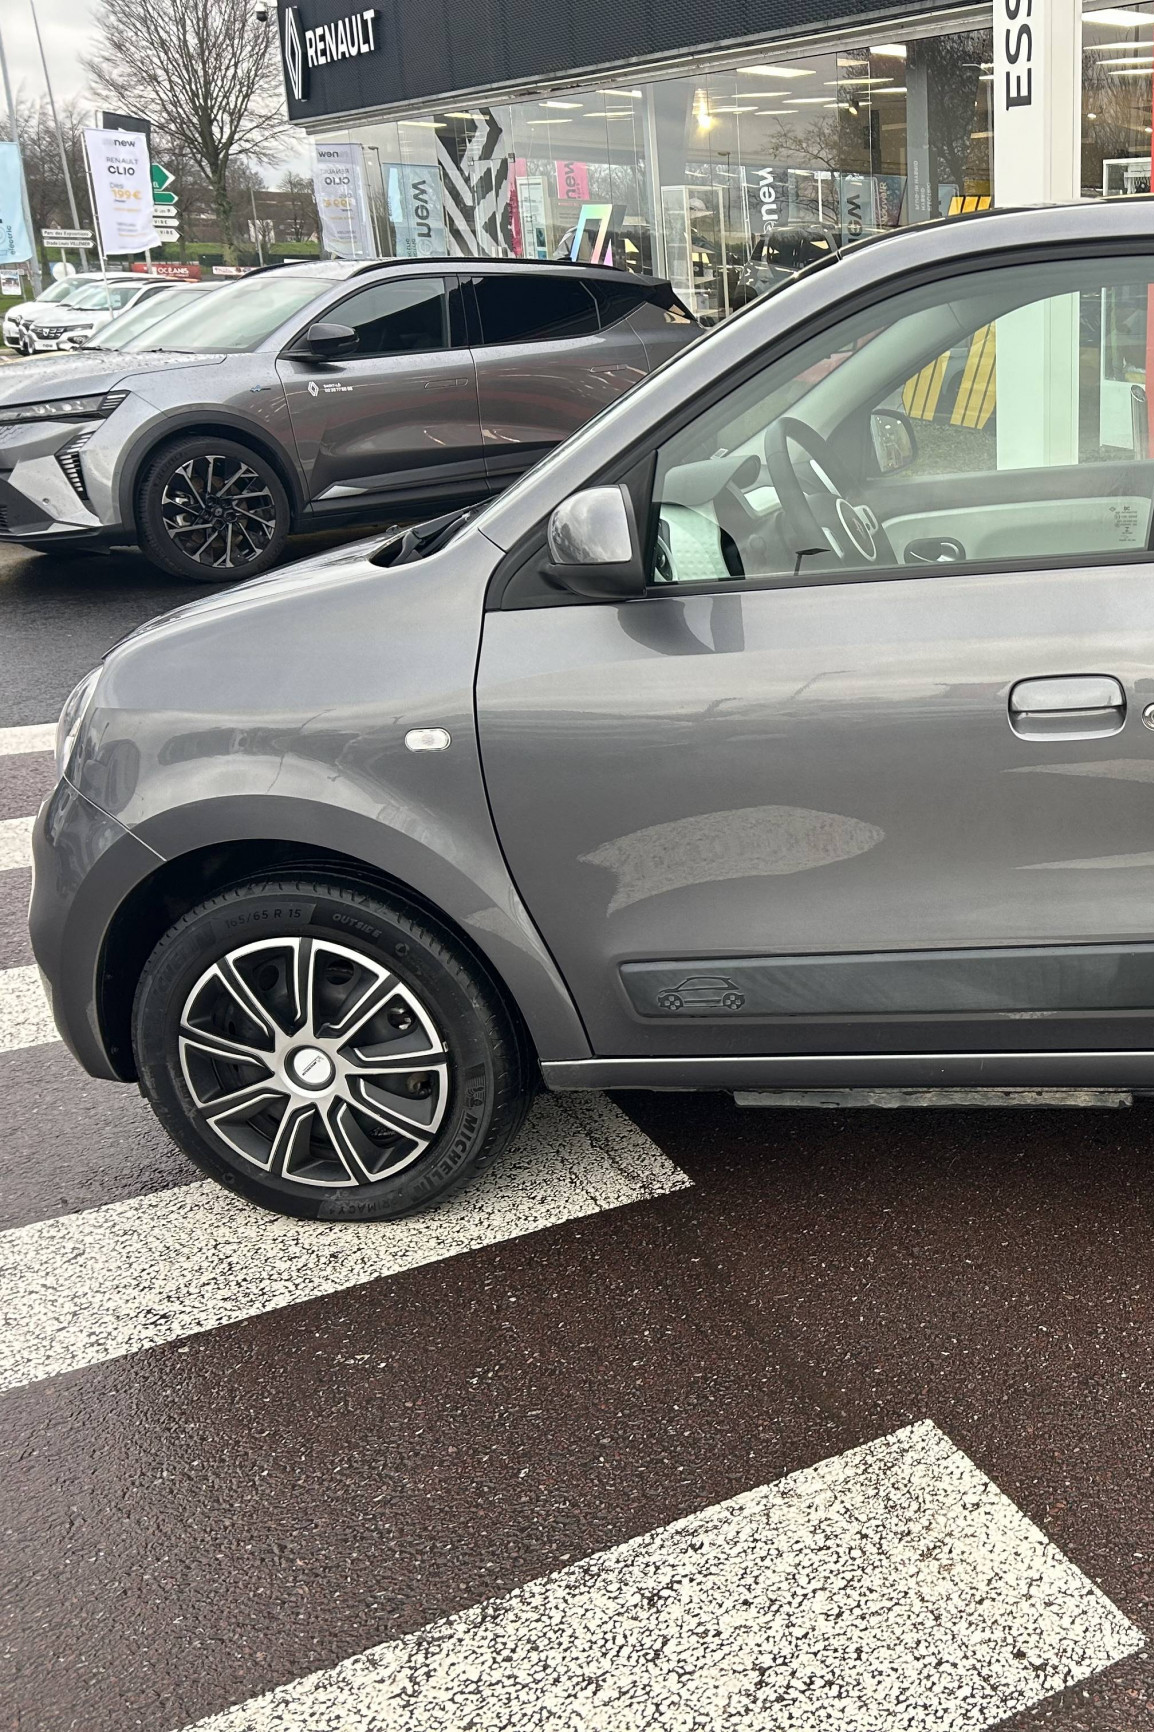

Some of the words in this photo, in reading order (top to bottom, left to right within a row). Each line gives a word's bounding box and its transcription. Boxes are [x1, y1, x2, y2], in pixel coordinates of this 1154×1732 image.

[305, 9, 375, 68] RENAULT
[114, 139, 136, 147] new
[106, 157, 139, 165] RENAULT
[107, 165, 136, 176] CLIO
[6, 225, 16, 255] electric
[274, 908, 282, 919] R
[289, 909, 301, 919] 15
[332, 913, 382, 938] OUTSIDE
[413, 1112, 478, 1192] MICHELIN
